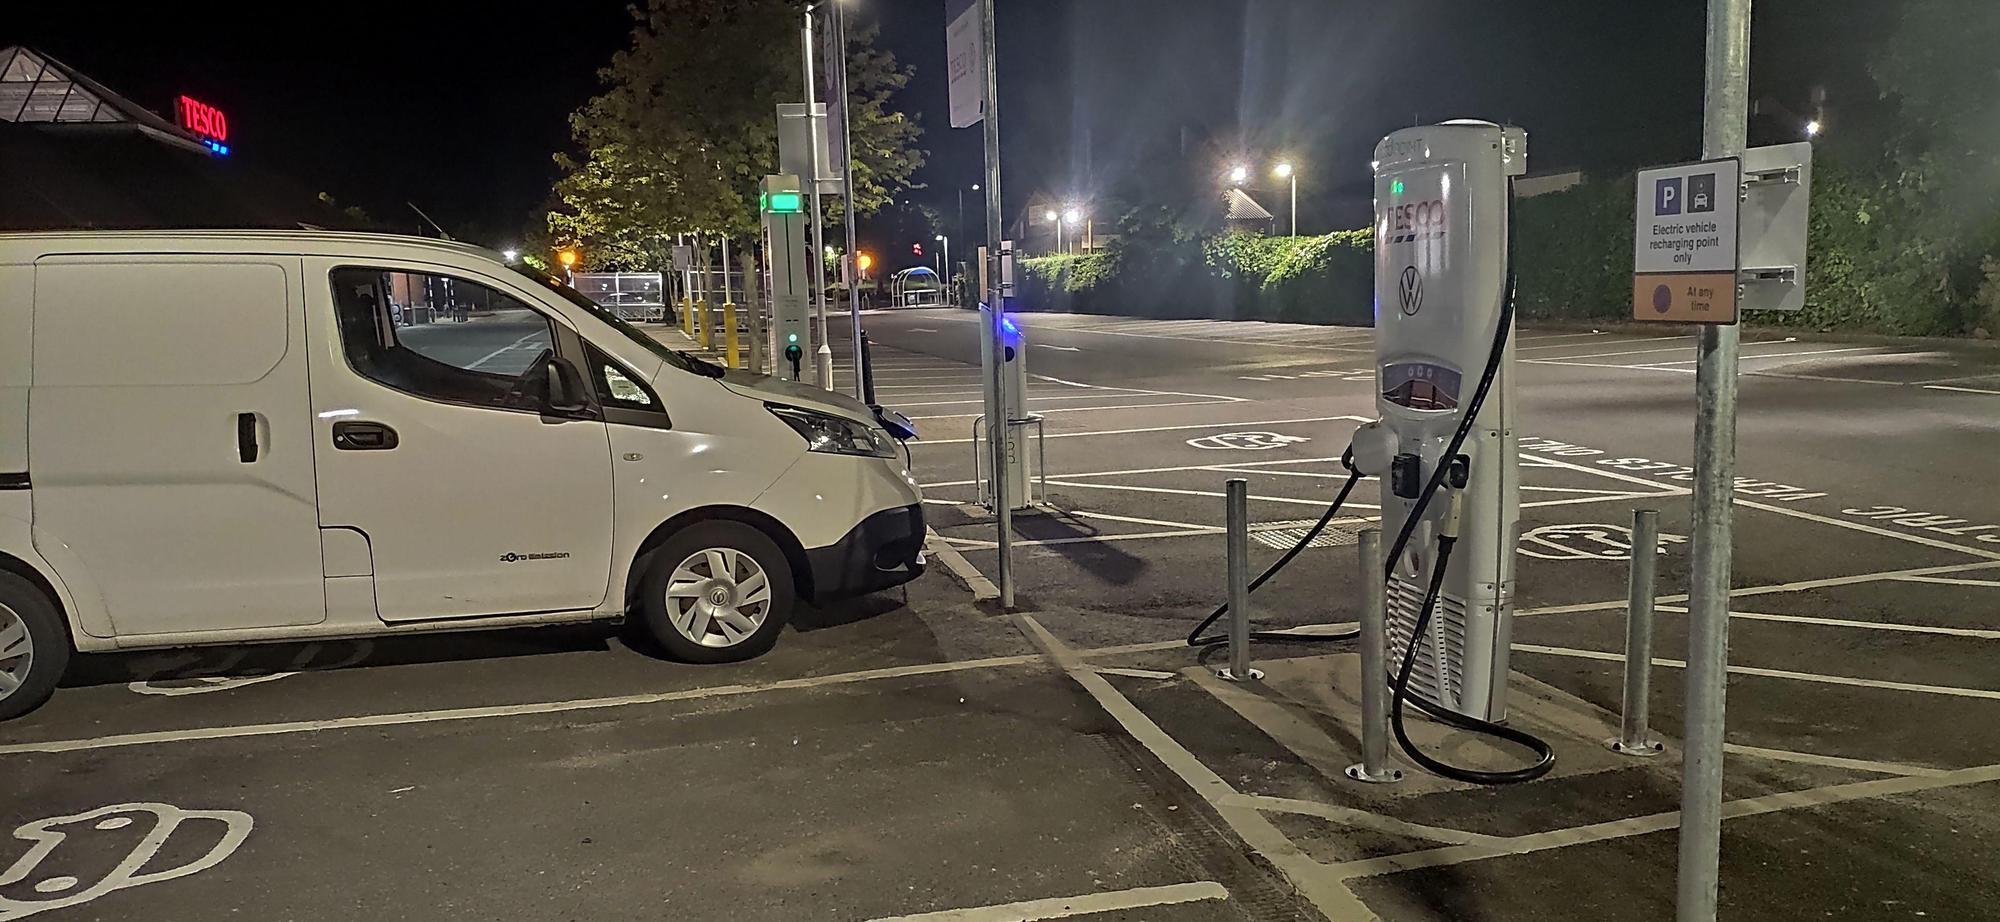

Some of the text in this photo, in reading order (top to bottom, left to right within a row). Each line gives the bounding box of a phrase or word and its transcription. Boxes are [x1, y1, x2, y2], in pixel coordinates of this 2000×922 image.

[181, 95, 226, 141] TESCO
[1663, 186, 1675, 208] P
[1386, 200, 1444, 231] TESCO
[1652, 221, 1717, 235] Electric vehicle
[1650, 235, 1719, 251] recharging point
[1673, 252, 1692, 265] only
[1687, 285, 1714, 300] At any
[1691, 301, 1710, 312] time
